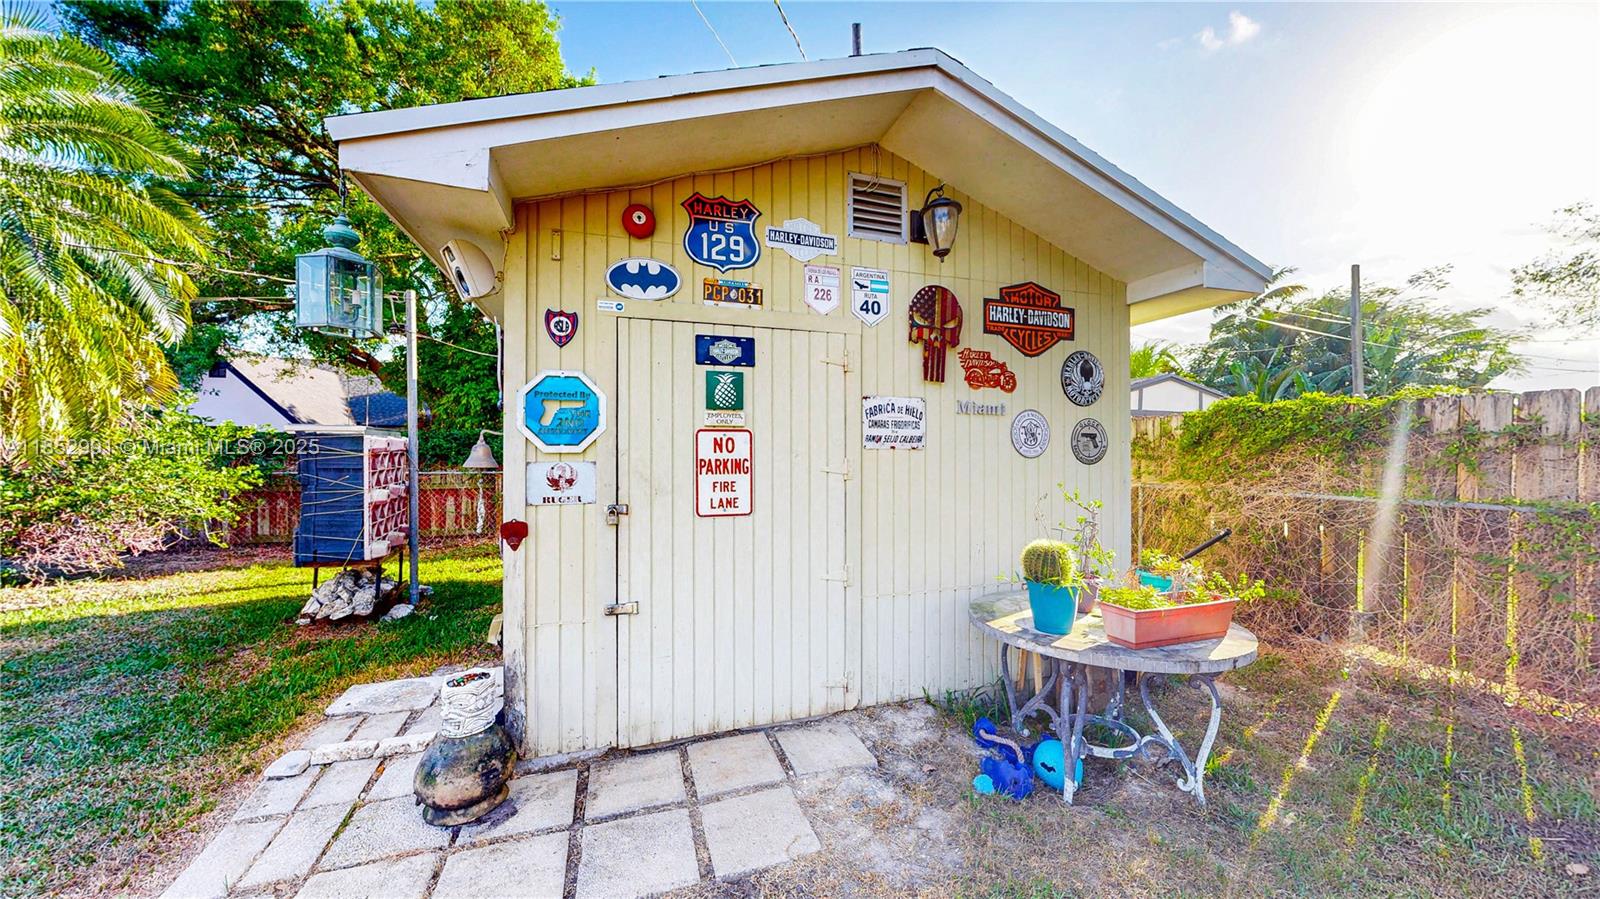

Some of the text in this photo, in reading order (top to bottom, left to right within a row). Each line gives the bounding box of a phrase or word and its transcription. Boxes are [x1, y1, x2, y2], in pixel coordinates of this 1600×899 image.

[694, 202, 748, 219] HARLEY
[701, 232, 744, 262] 129
[769, 230, 834, 249] HARLEY-DAVIDSON
[738, 288, 762, 304] 031
[814, 288, 832, 301] 226
[1010, 288, 1052, 307] MOTOR
[860, 300, 881, 315] 40
[989, 305, 1070, 329] HARLEY-DAVIDSON
[1009, 329, 1052, 350] CYCLES
[962, 350, 988, 359] HARLEY
[580, 391, 591, 400] By
[864, 402, 896, 420] FABRICA
[905, 404, 923, 421] HIELO
[713, 437, 735, 453] NO
[699, 458, 749, 475] PARKING
[713, 481, 736, 492] FIRE
[710, 497, 739, 509] LANE
